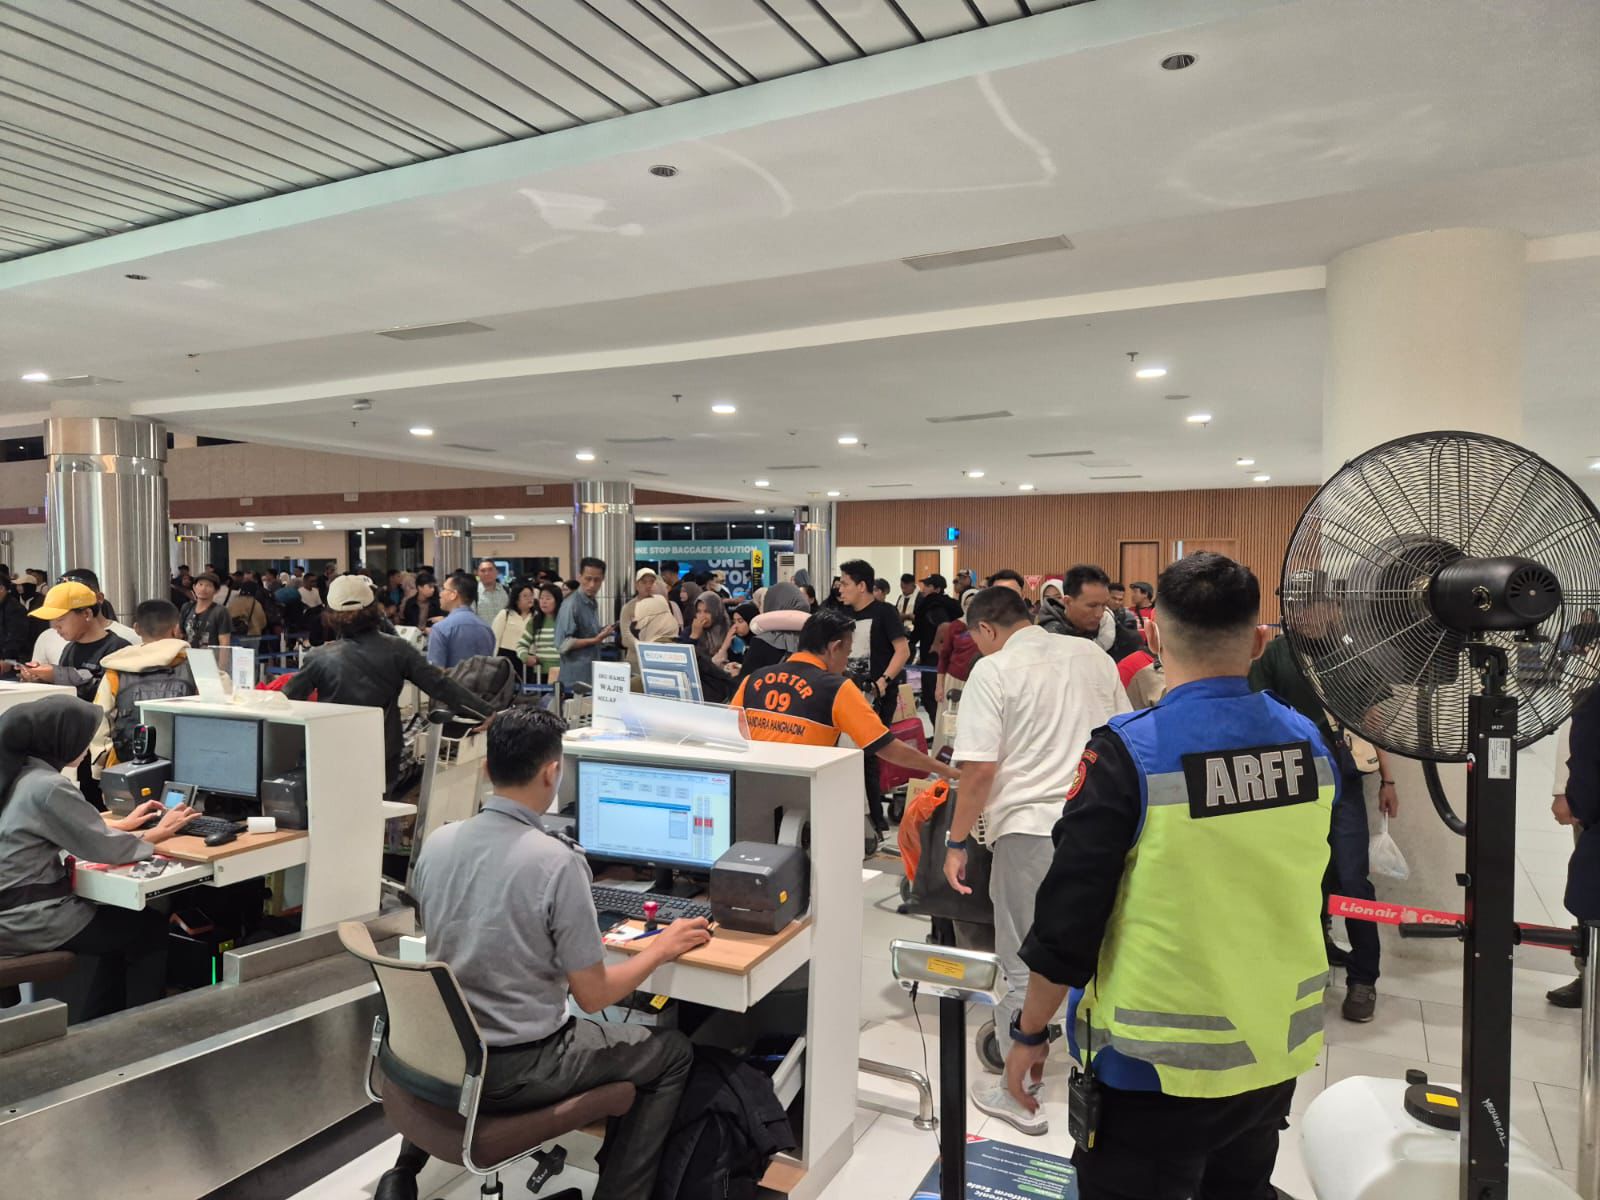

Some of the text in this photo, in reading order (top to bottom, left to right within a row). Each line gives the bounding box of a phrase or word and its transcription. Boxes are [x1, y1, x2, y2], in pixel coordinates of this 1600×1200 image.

[650, 546, 670, 554] STOP
[672, 546, 712, 554] BAGGAGE
[708, 559, 745, 568] ONE
[600, 684, 624, 694] WAJIB
[753, 672, 813, 699] PORTER
[765, 690, 791, 712] 09
[1206, 749, 1304, 807] ARFF
